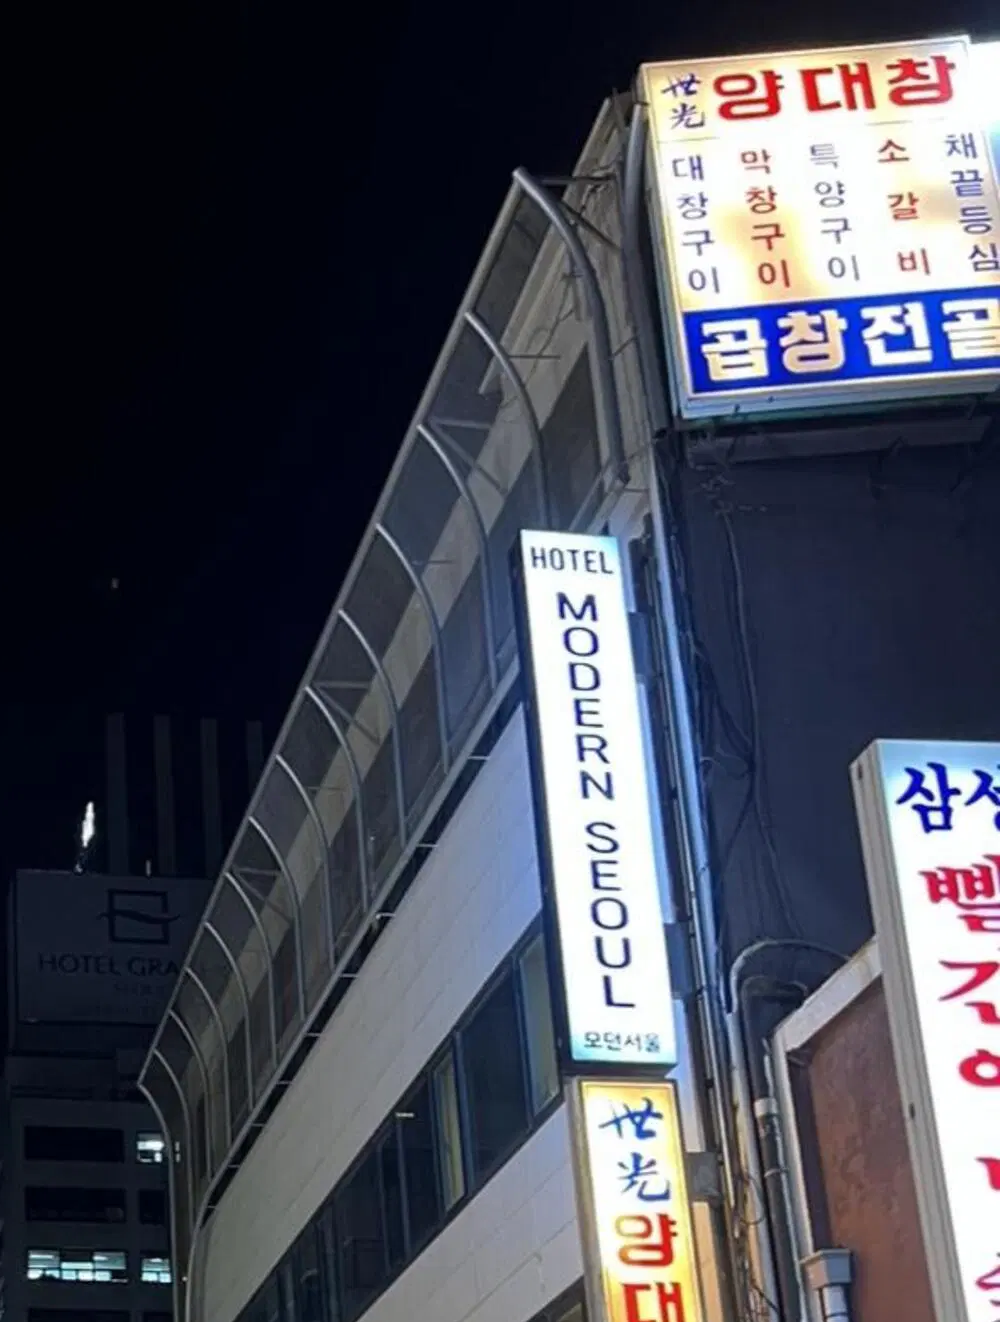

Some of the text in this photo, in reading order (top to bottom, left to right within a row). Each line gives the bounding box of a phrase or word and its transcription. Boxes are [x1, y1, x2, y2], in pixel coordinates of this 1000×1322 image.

[713, 54, 956, 121] 양대창
[672, 154, 720, 295] 대창구이
[740, 148, 791, 289] 막창구이
[808, 143, 860, 282] 특양구이
[877, 138, 931, 277] 소갈비
[944, 132, 1000, 273] 채끝등심
[702, 297, 1000, 382] 곱창전골
[530, 546, 615, 575] HOTEL
[556, 592, 636, 1008] MODERN SEOUL
[38, 951, 122, 977] HOTEL
